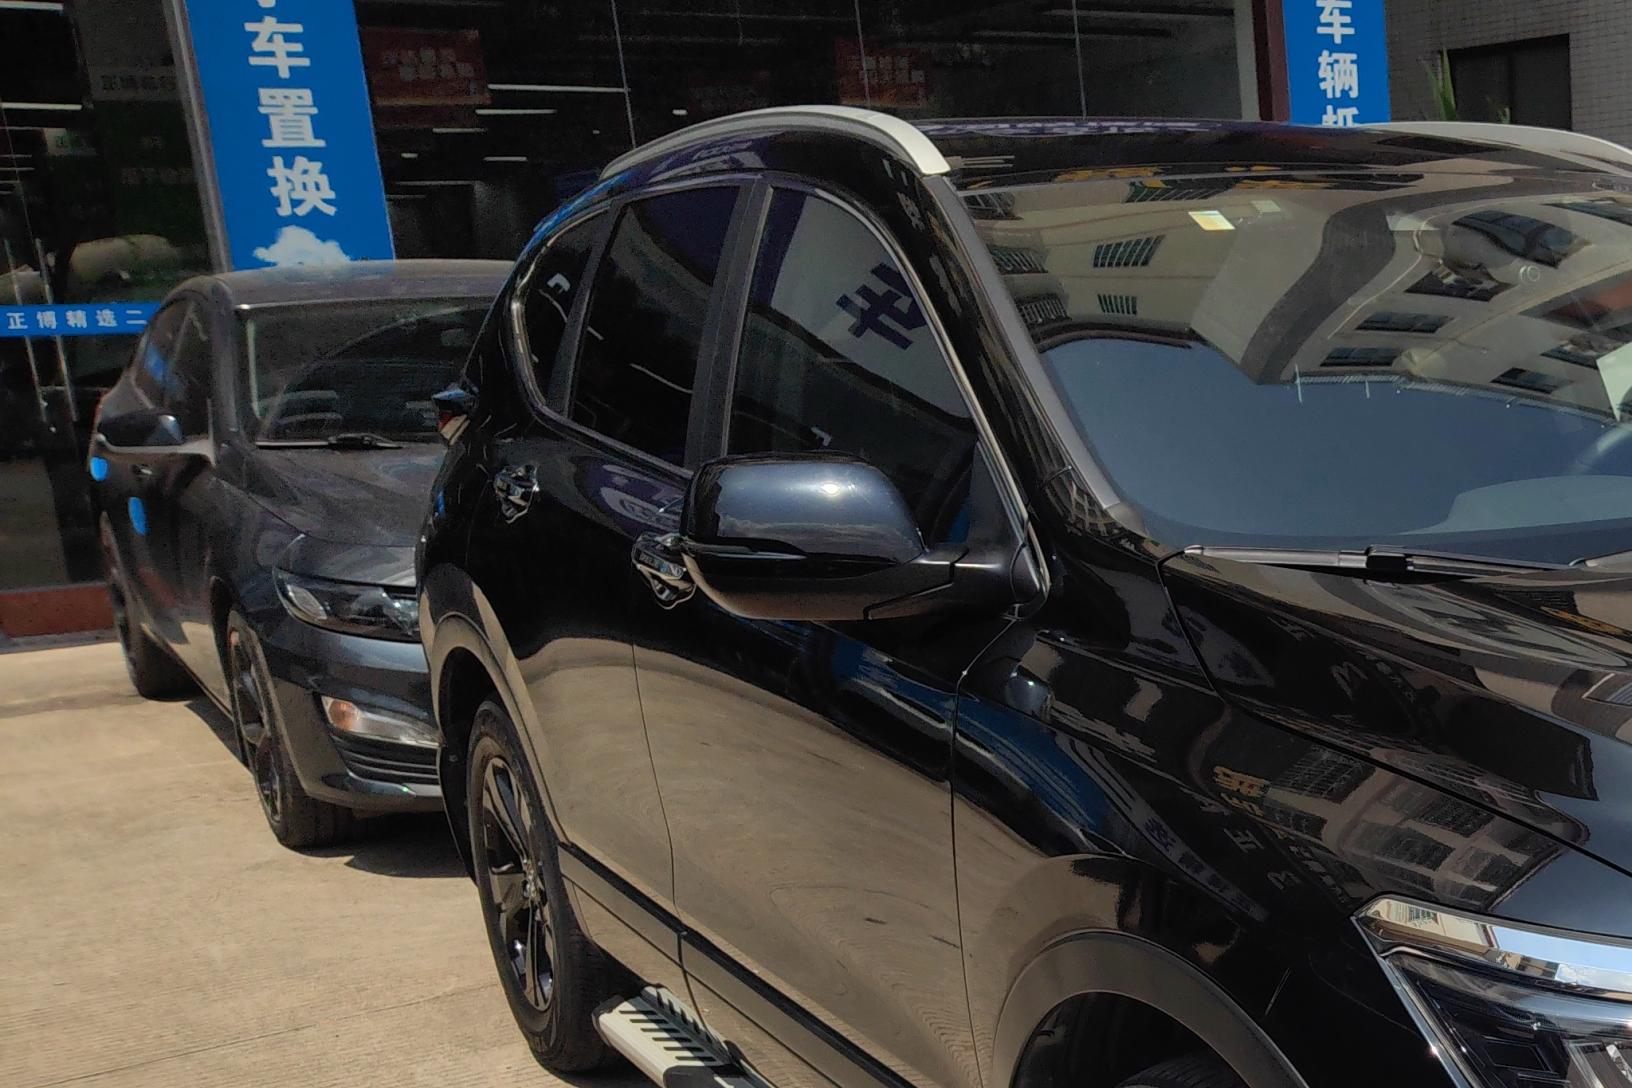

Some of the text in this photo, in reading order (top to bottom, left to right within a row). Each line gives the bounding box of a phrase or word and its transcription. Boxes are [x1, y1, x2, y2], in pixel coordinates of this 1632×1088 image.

[244, 0, 338, 217] 车置换
[7, 308, 147, 330] 正博精选二
